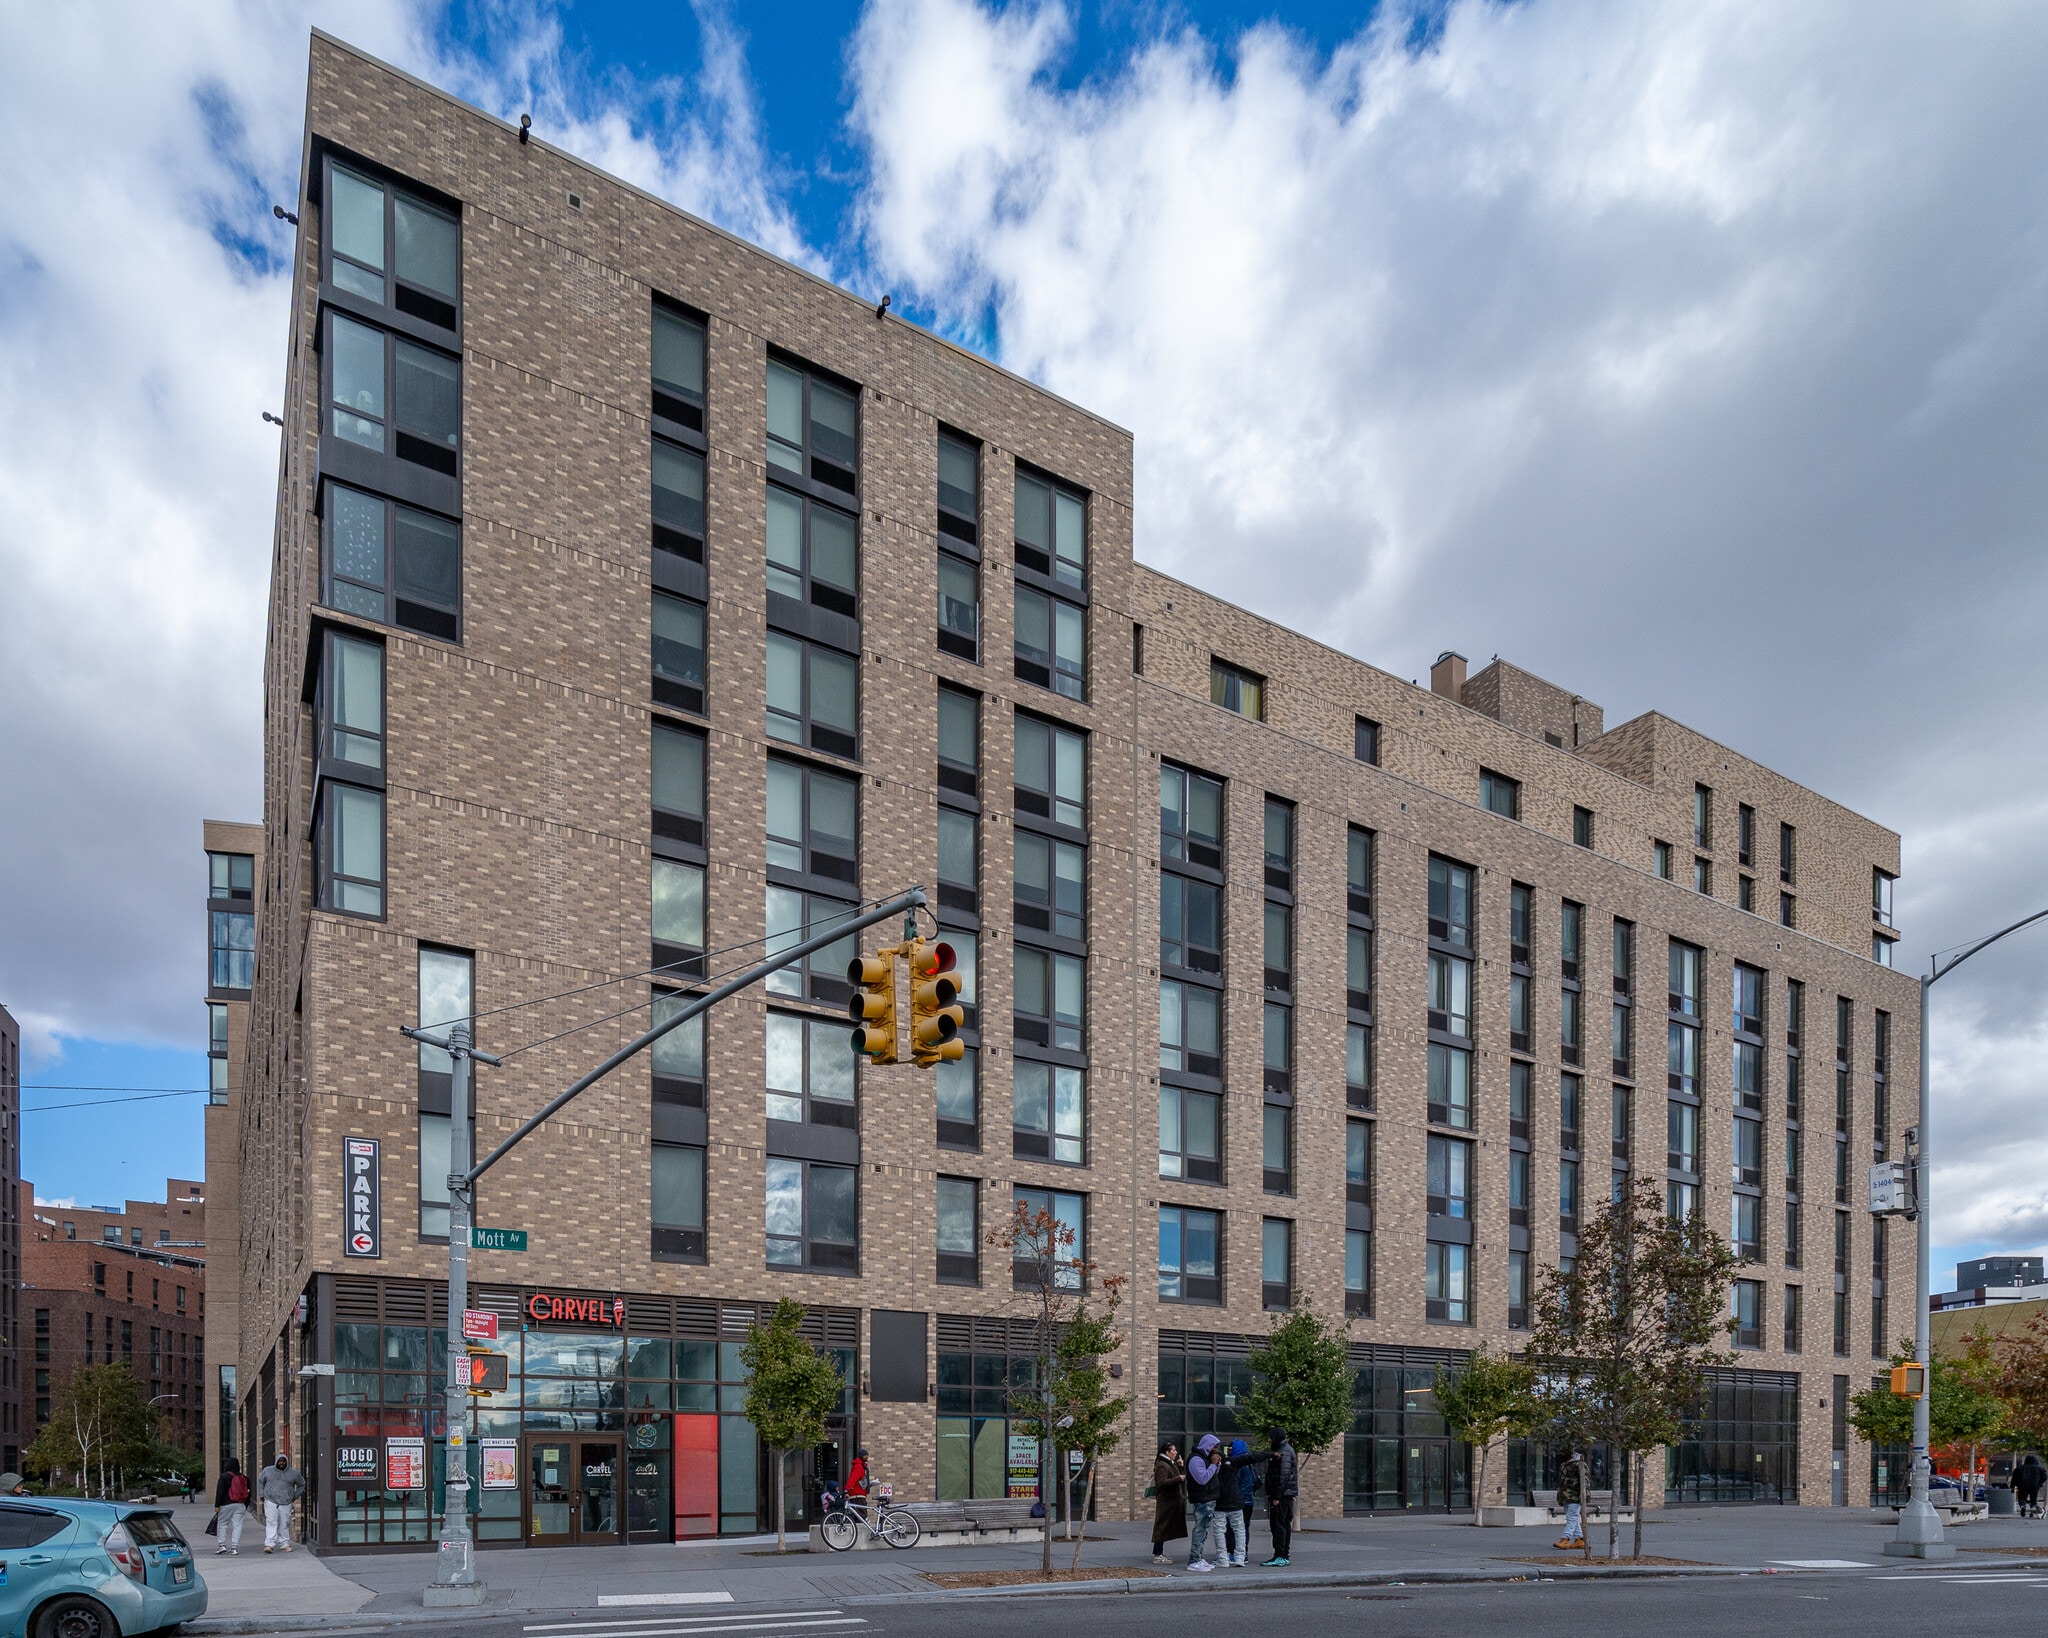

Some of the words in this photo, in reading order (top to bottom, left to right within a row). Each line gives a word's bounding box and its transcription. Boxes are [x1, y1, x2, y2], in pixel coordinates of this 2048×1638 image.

[352, 1156, 372, 1232] PARK
[477, 1231, 505, 1247] Mott
[510, 1234, 520, 1243] Av
[529, 1293, 611, 1322] CARVEL
[472, 1313, 493, 1321] STANDING
[342, 1449, 373, 1462] BOGO
[338, 1460, 376, 1469] Wednesday
[586, 1463, 612, 1474] CARVEL
